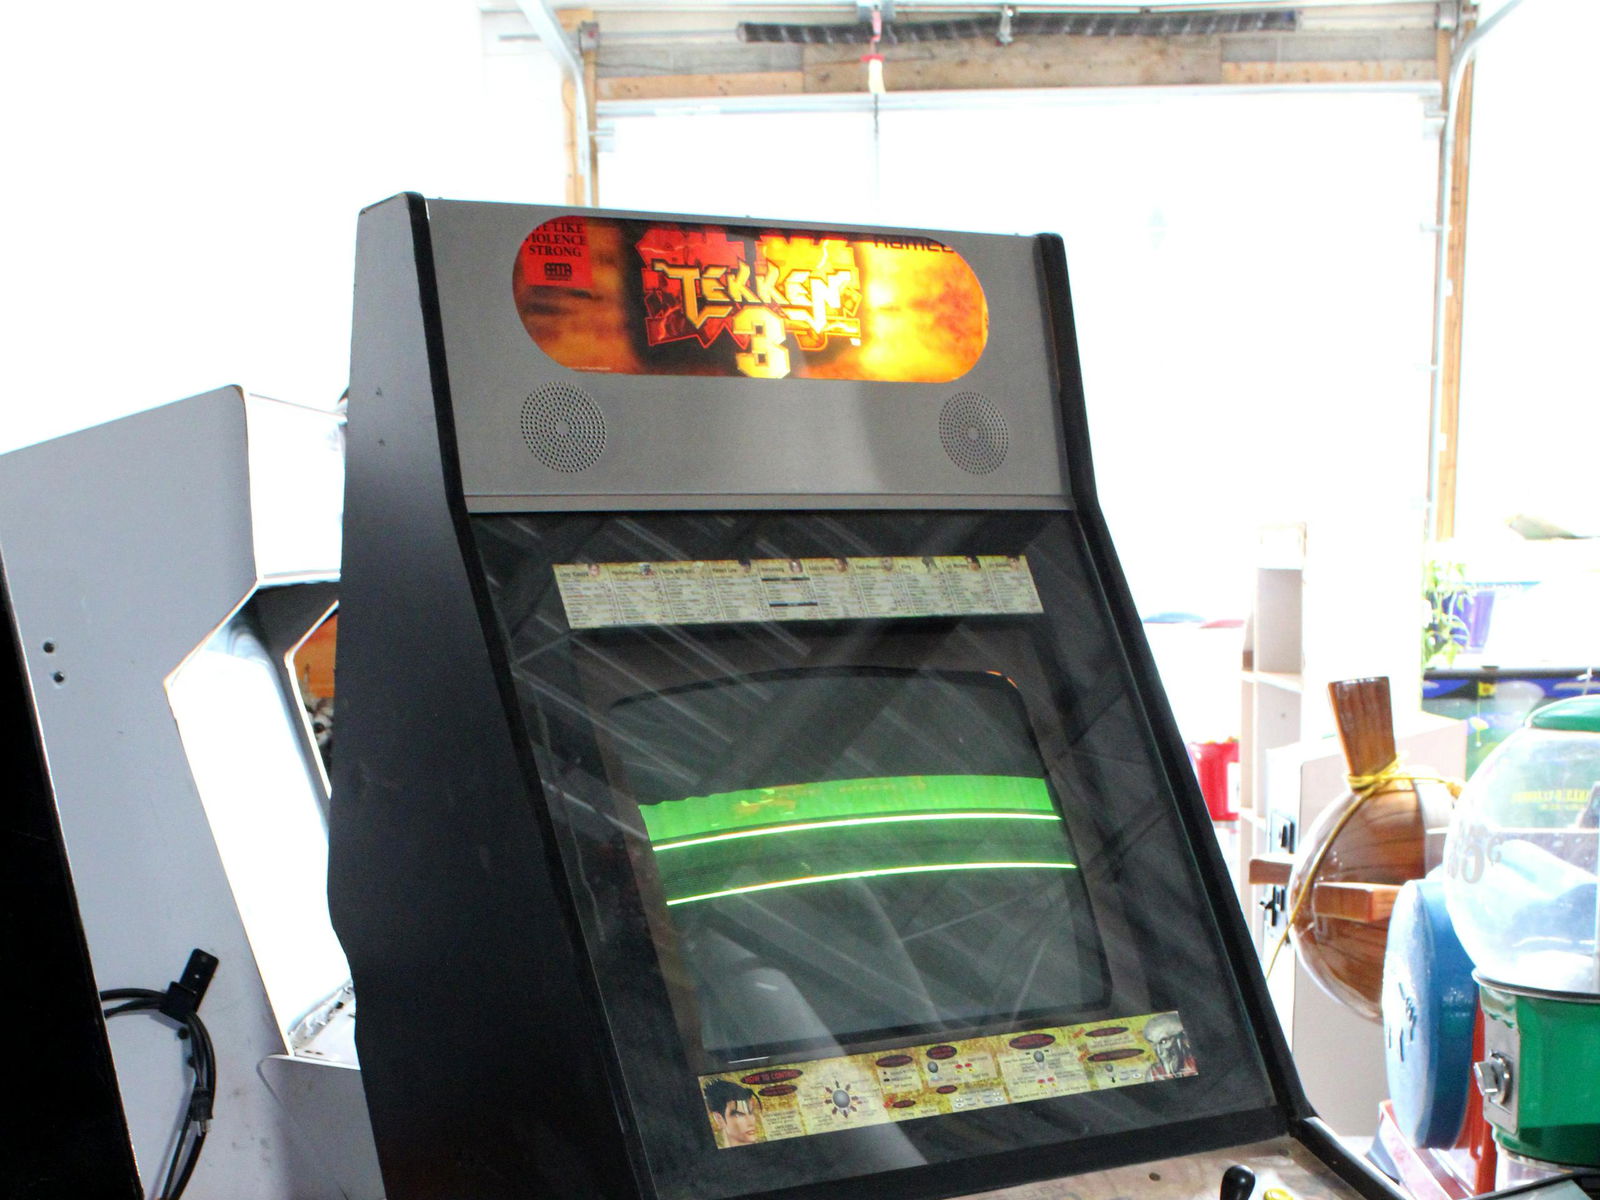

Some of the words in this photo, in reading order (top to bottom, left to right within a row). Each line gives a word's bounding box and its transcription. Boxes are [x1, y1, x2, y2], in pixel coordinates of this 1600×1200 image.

[553, 222, 584, 234] LIKE
[525, 231, 587, 247] IOLENCE
[528, 244, 582, 257] STRONG
[653, 255, 852, 334] TEKKEN
[731, 304, 792, 379] 3
